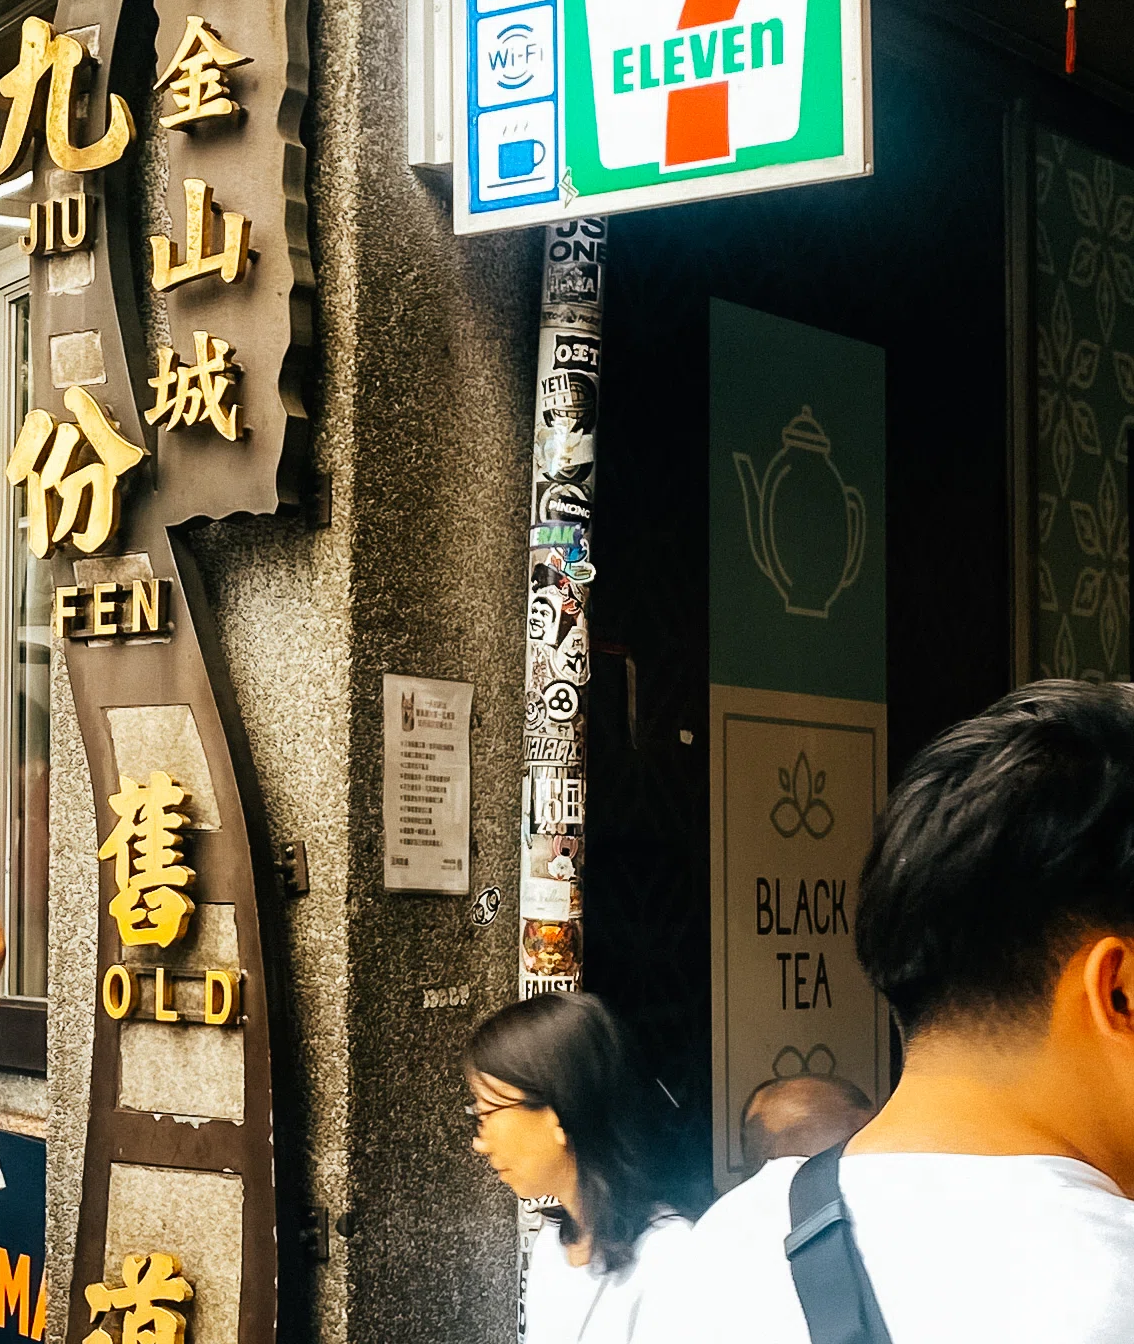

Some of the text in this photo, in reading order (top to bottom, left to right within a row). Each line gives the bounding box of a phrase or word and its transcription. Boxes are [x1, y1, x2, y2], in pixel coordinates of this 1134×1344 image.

[488, 45, 544, 71] Wi-Fi
[18, 193, 94, 256] JIU
[541, 373, 569, 396] YETI
[56, 578, 166, 638] FEN
[755, 876, 849, 937] BLACK
[103, 964, 241, 1026] OLD
[776, 952, 833, 1011] TEA
